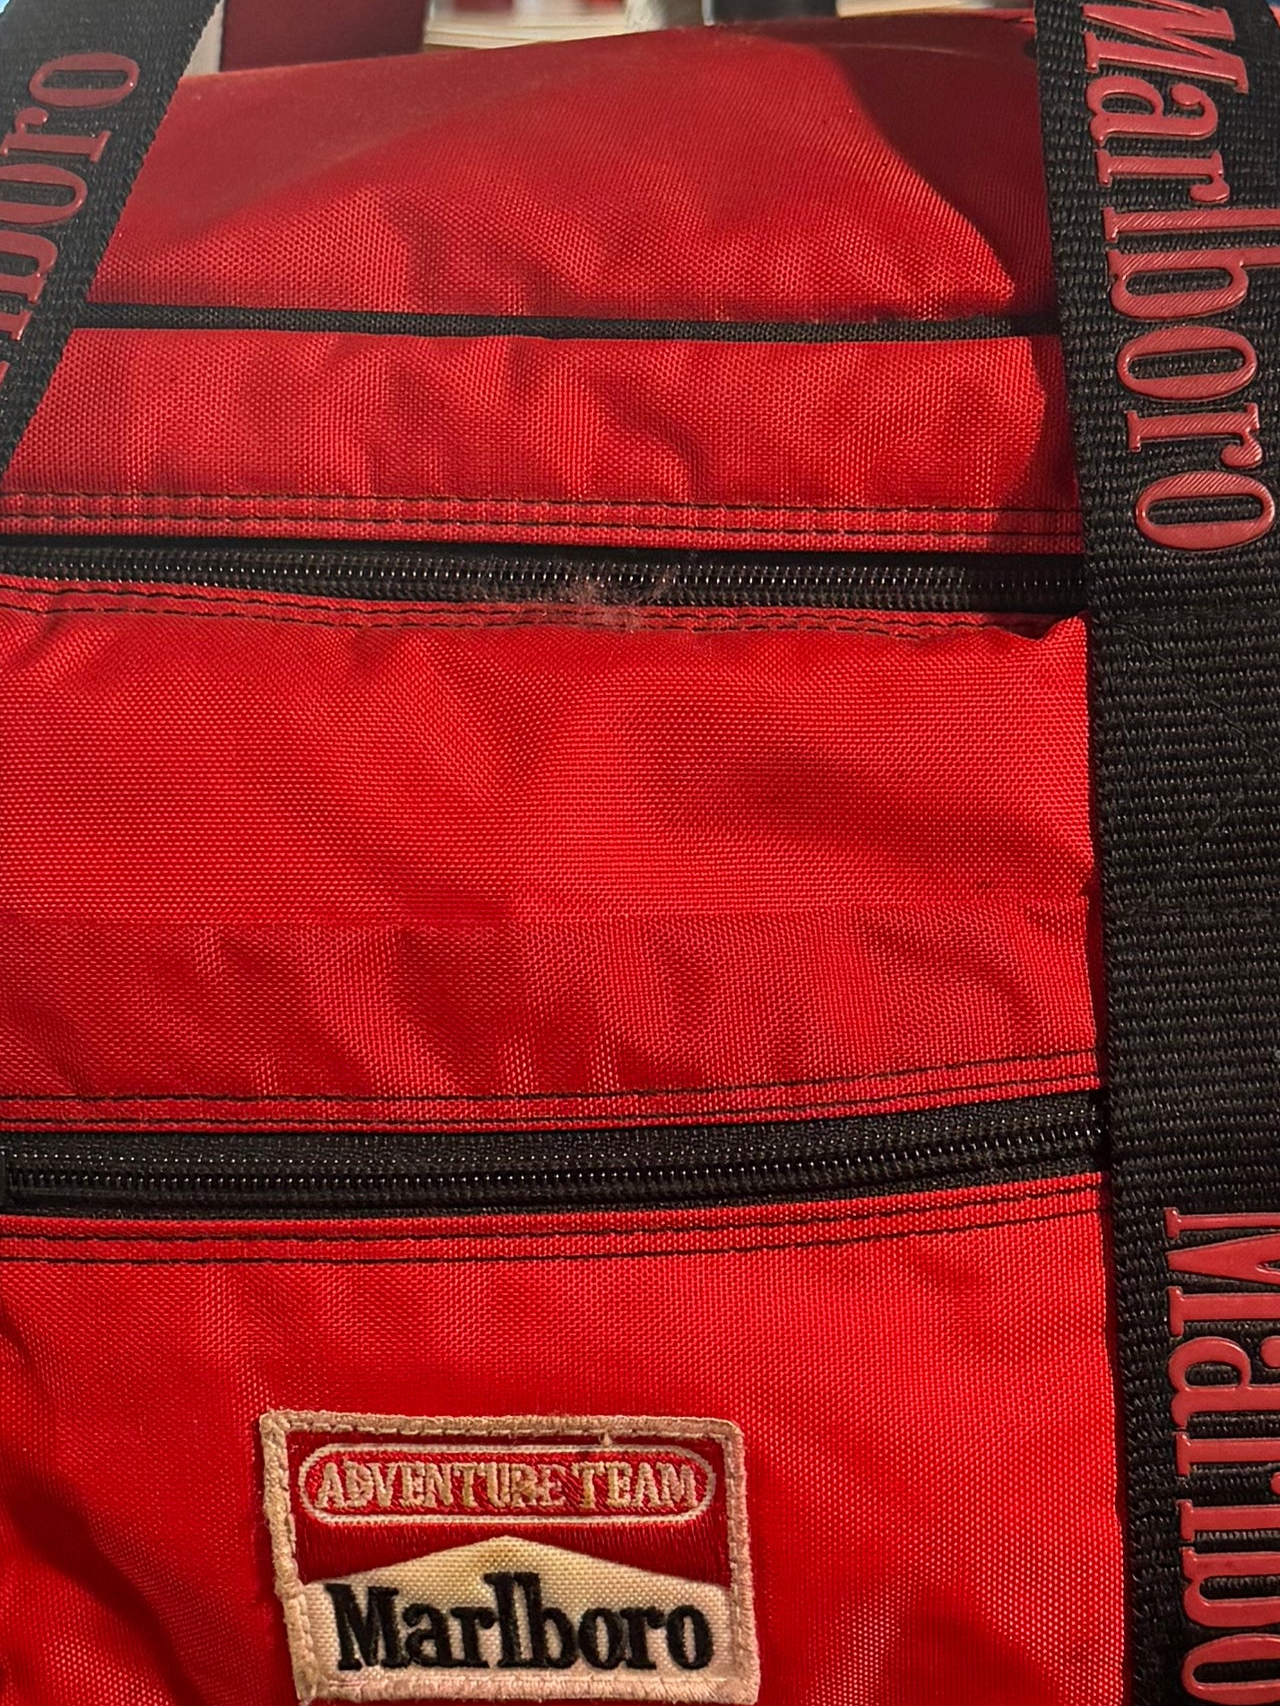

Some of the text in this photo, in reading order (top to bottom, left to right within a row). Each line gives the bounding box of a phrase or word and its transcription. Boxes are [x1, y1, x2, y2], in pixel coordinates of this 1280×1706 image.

[314, 1461, 699, 1510] ADVENTURE TEAM
[325, 1571, 716, 1672] Marlboro
